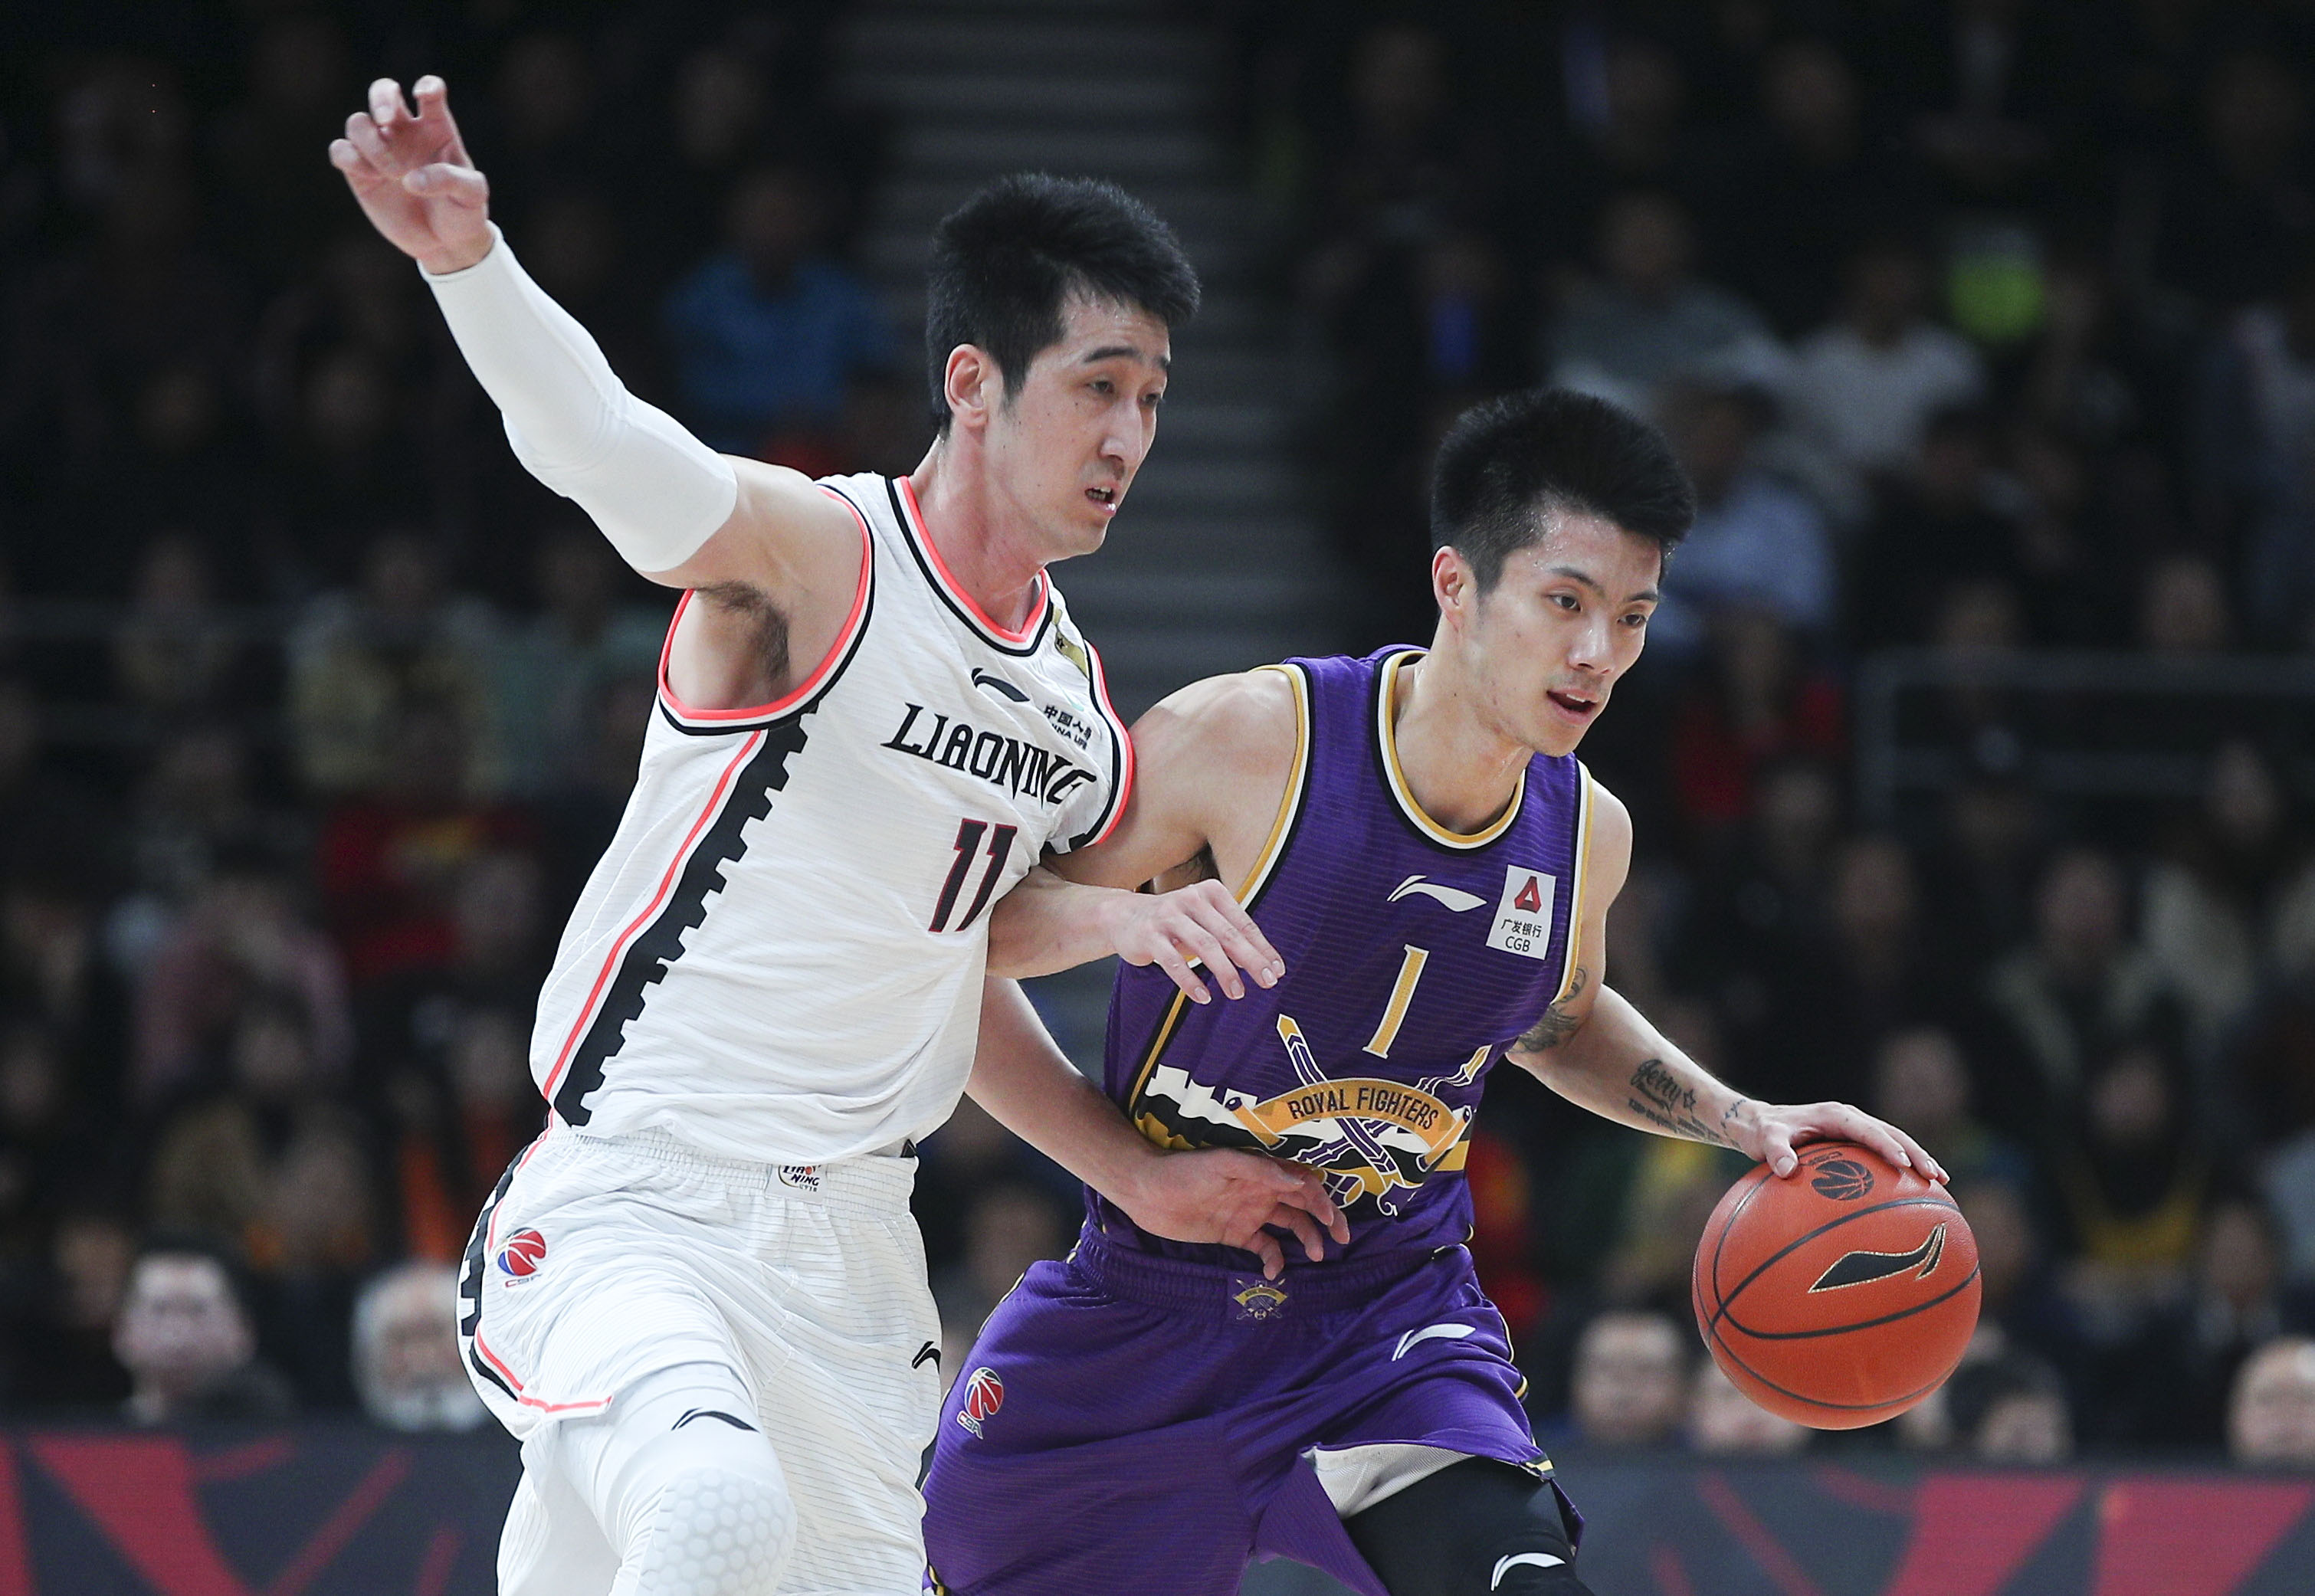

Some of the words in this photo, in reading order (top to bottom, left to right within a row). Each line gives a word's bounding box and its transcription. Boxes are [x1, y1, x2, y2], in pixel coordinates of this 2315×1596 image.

[880, 703, 1097, 808] LIAONING
[928, 818, 1018, 932] 11
[1501, 919, 1543, 939] 广发银行
[1505, 936, 1531, 952] CGB
[1362, 944, 1429, 1059] 1
[1287, 1088, 1350, 1120] ROYAL
[1356, 1086, 1439, 1130] FIGHTERS
[791, 1174, 820, 1186] NING
[957, 1411, 983, 1439] CBA
